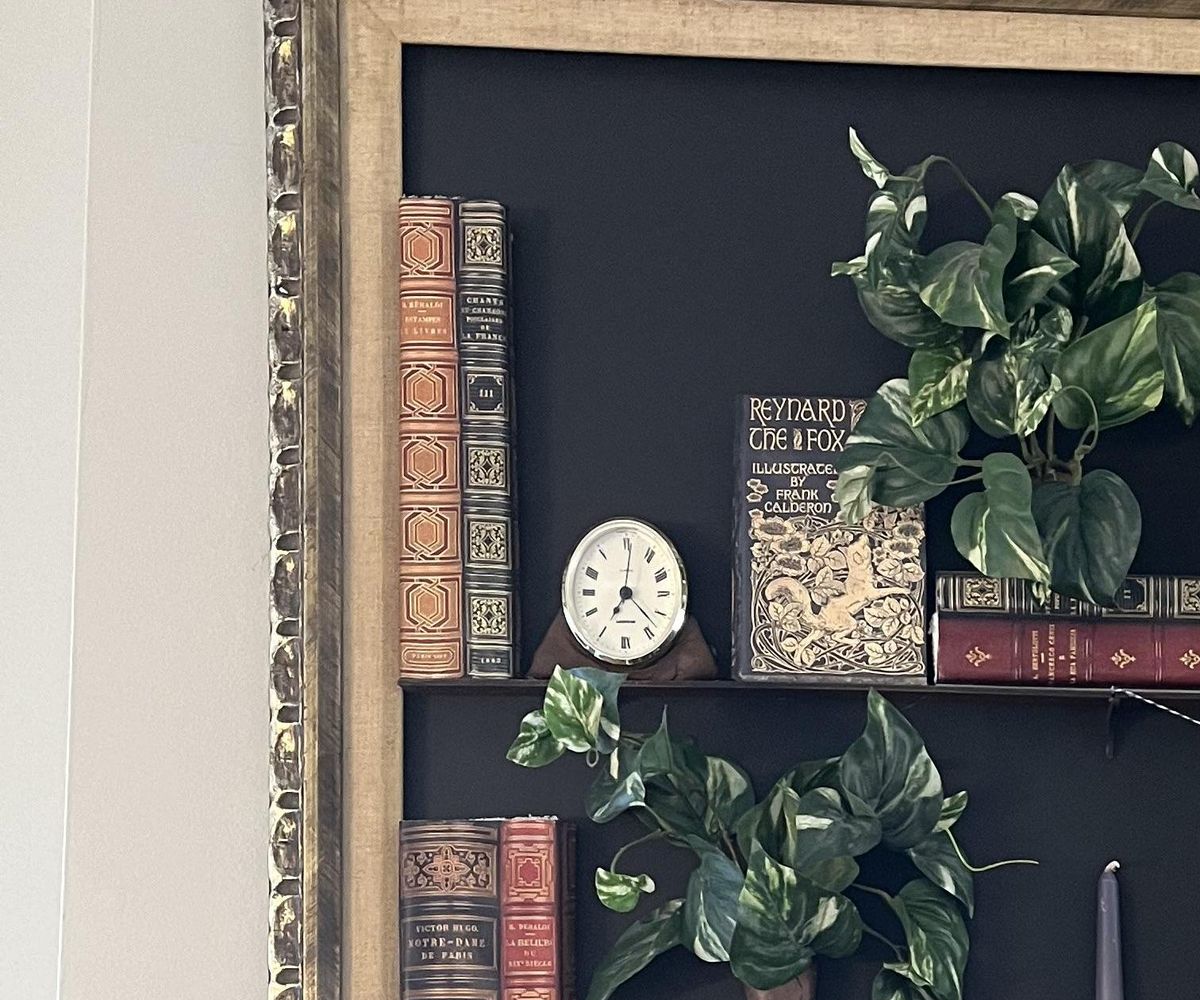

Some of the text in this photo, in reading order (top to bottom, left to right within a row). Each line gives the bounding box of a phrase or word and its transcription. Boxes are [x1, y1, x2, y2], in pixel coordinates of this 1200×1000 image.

[479, 388, 495, 398] III
[750, 397, 845, 429] REYNARD
[749, 427, 845, 452] THE FOX
[790, 476, 807, 488] BY
[776, 490, 819, 502] FRANK
[764, 502, 832, 516] CALDERON
[415, 924, 449, 933] VICTOR
[408, 937, 486, 948] NOTRE-DAME
[421, 951, 473, 960] DE PARIS
